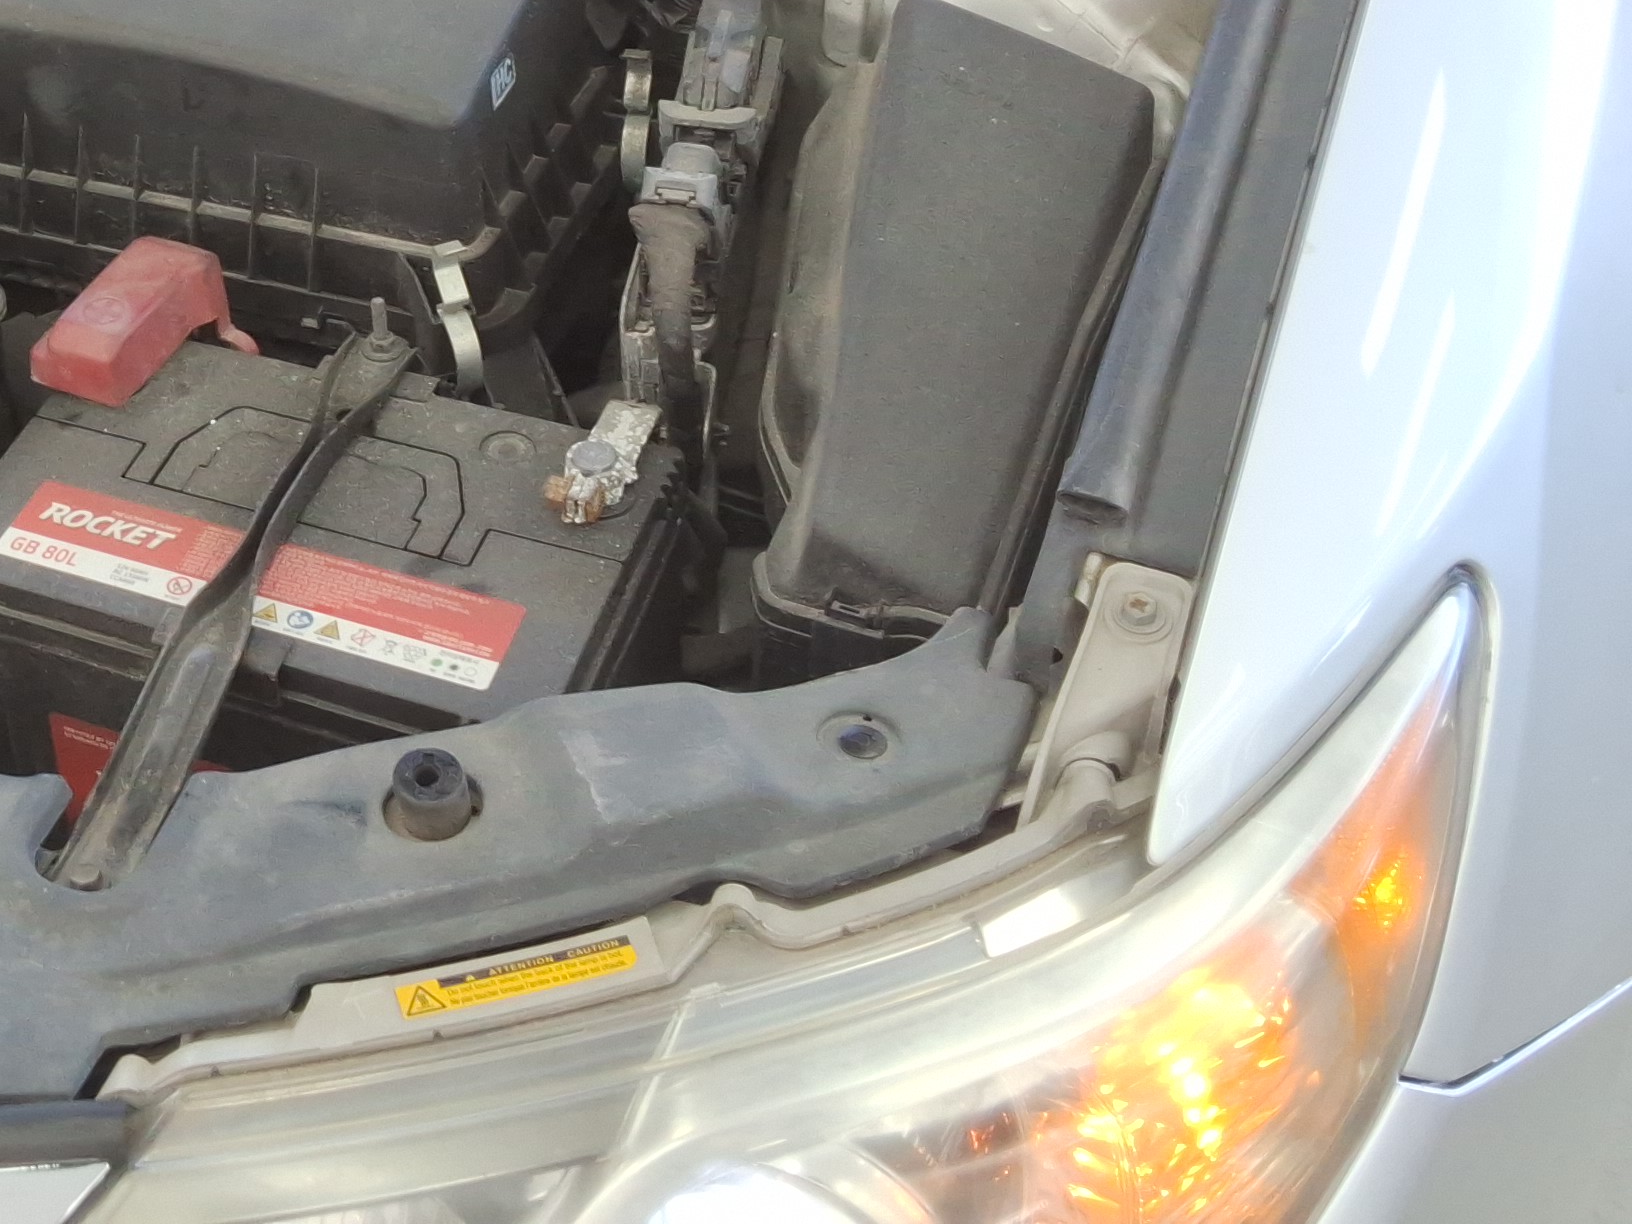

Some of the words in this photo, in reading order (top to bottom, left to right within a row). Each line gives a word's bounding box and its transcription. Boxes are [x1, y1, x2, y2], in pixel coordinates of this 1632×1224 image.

[38, 501, 176, 550] ROCKET
[10, 536, 39, 554] GB
[42, 545, 76, 567] 80L
[488, 954, 554, 976] ATTENTION
[567, 939, 619, 958] CAUTION
